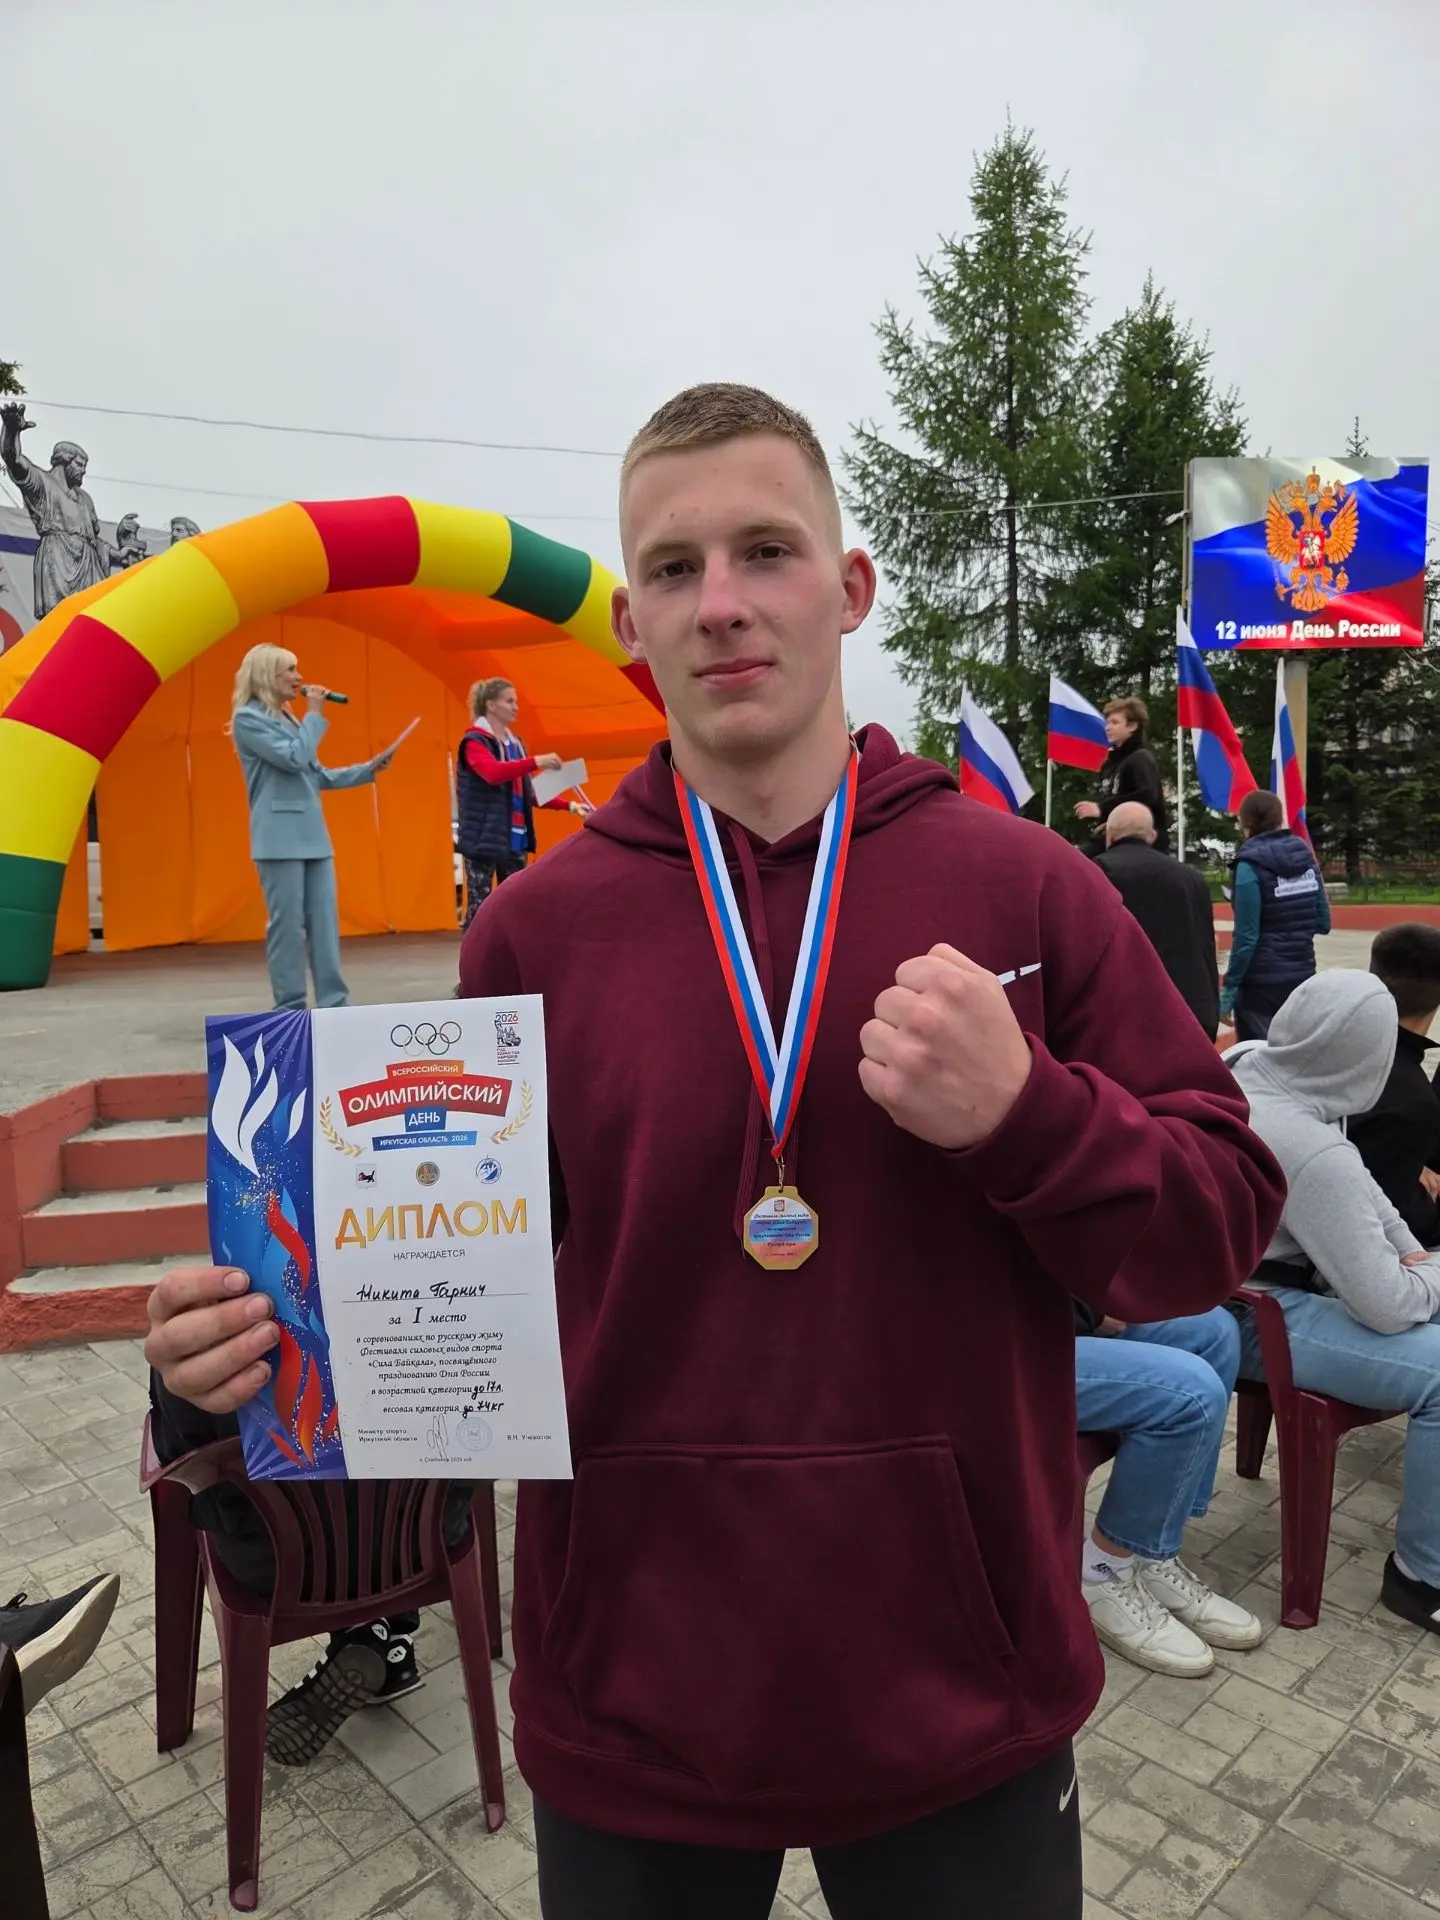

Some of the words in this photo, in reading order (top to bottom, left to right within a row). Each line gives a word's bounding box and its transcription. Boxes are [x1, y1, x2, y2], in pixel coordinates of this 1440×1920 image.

[1215, 621, 1236, 639] 12
[1240, 624, 1287, 639] июня
[1289, 620, 1335, 641] День
[1338, 619, 1401, 638] России
[495, 1013, 519, 1023] 2026
[392, 1064, 459, 1077] ВСЕРОССИЙСКИЙ
[348, 1081, 503, 1114] ОЛИМПИЙСКИЙ
[408, 1111, 441, 1126] ДЕНЬ
[380, 1137, 417, 1146] ИРКУТСКАЯ
[418, 1135, 448, 1144] ОБЛАСТЬ
[451, 1134, 468, 1142] 2026
[335, 1198, 528, 1250] ДИПЛОМ
[393, 1249, 466, 1261] НАГРАЖДАЕТСЯ
[356, 1284, 420, 1302] Никита
[388, 1315, 402, 1325] за
[428, 1313, 467, 1324] место
[362, 1334, 425, 1345] соревнованиях
[437, 1332, 477, 1345] русскому
[477, 1331, 504, 1344] жиму
[360, 1346, 408, 1357] Фестиваля
[409, 1346, 446, 1355] силовых
[446, 1344, 470, 1353] видов
[471, 1344, 503, 1355] спорта
[368, 1358, 393, 1368] «Сила
[394, 1357, 437, 1368] Байкала»,
[439, 1356, 497, 1367] посвящённого
[378, 1370, 438, 1381] празднованию
[439, 1369, 459, 1378] Дня
[460, 1368, 490, 1378] России
[378, 1386, 426, 1398] возрастной
[427, 1386, 472, 1398] категории
[383, 1405, 413, 1413] весовая
[415, 1405, 460, 1416] категория
